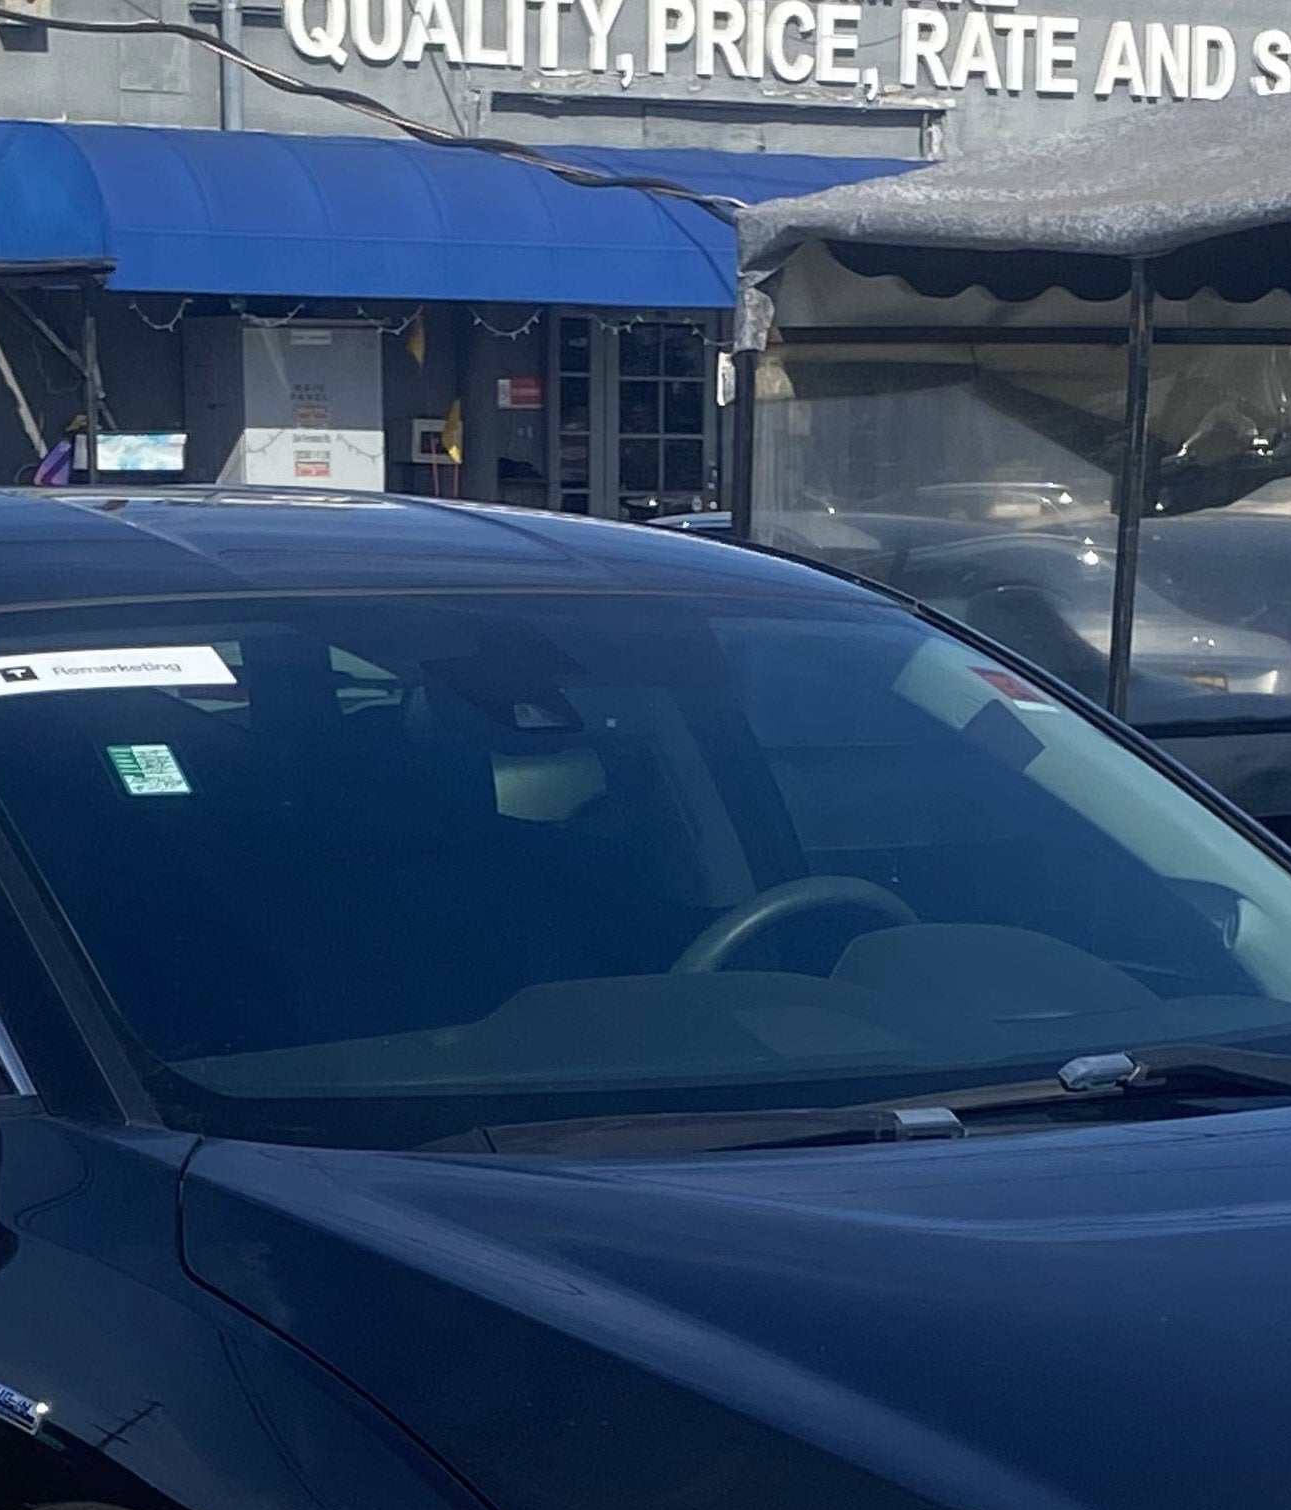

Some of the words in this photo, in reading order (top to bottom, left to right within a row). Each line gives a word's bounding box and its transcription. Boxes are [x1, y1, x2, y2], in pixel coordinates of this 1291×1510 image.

[283, 0, 634, 88] QUALITY,
[647, 0, 879, 101] PRICE,
[899, 8, 1079, 96] RATE
[1093, 20, 1236, 101] AND
[52, 661, 182, 676] Remarketing
